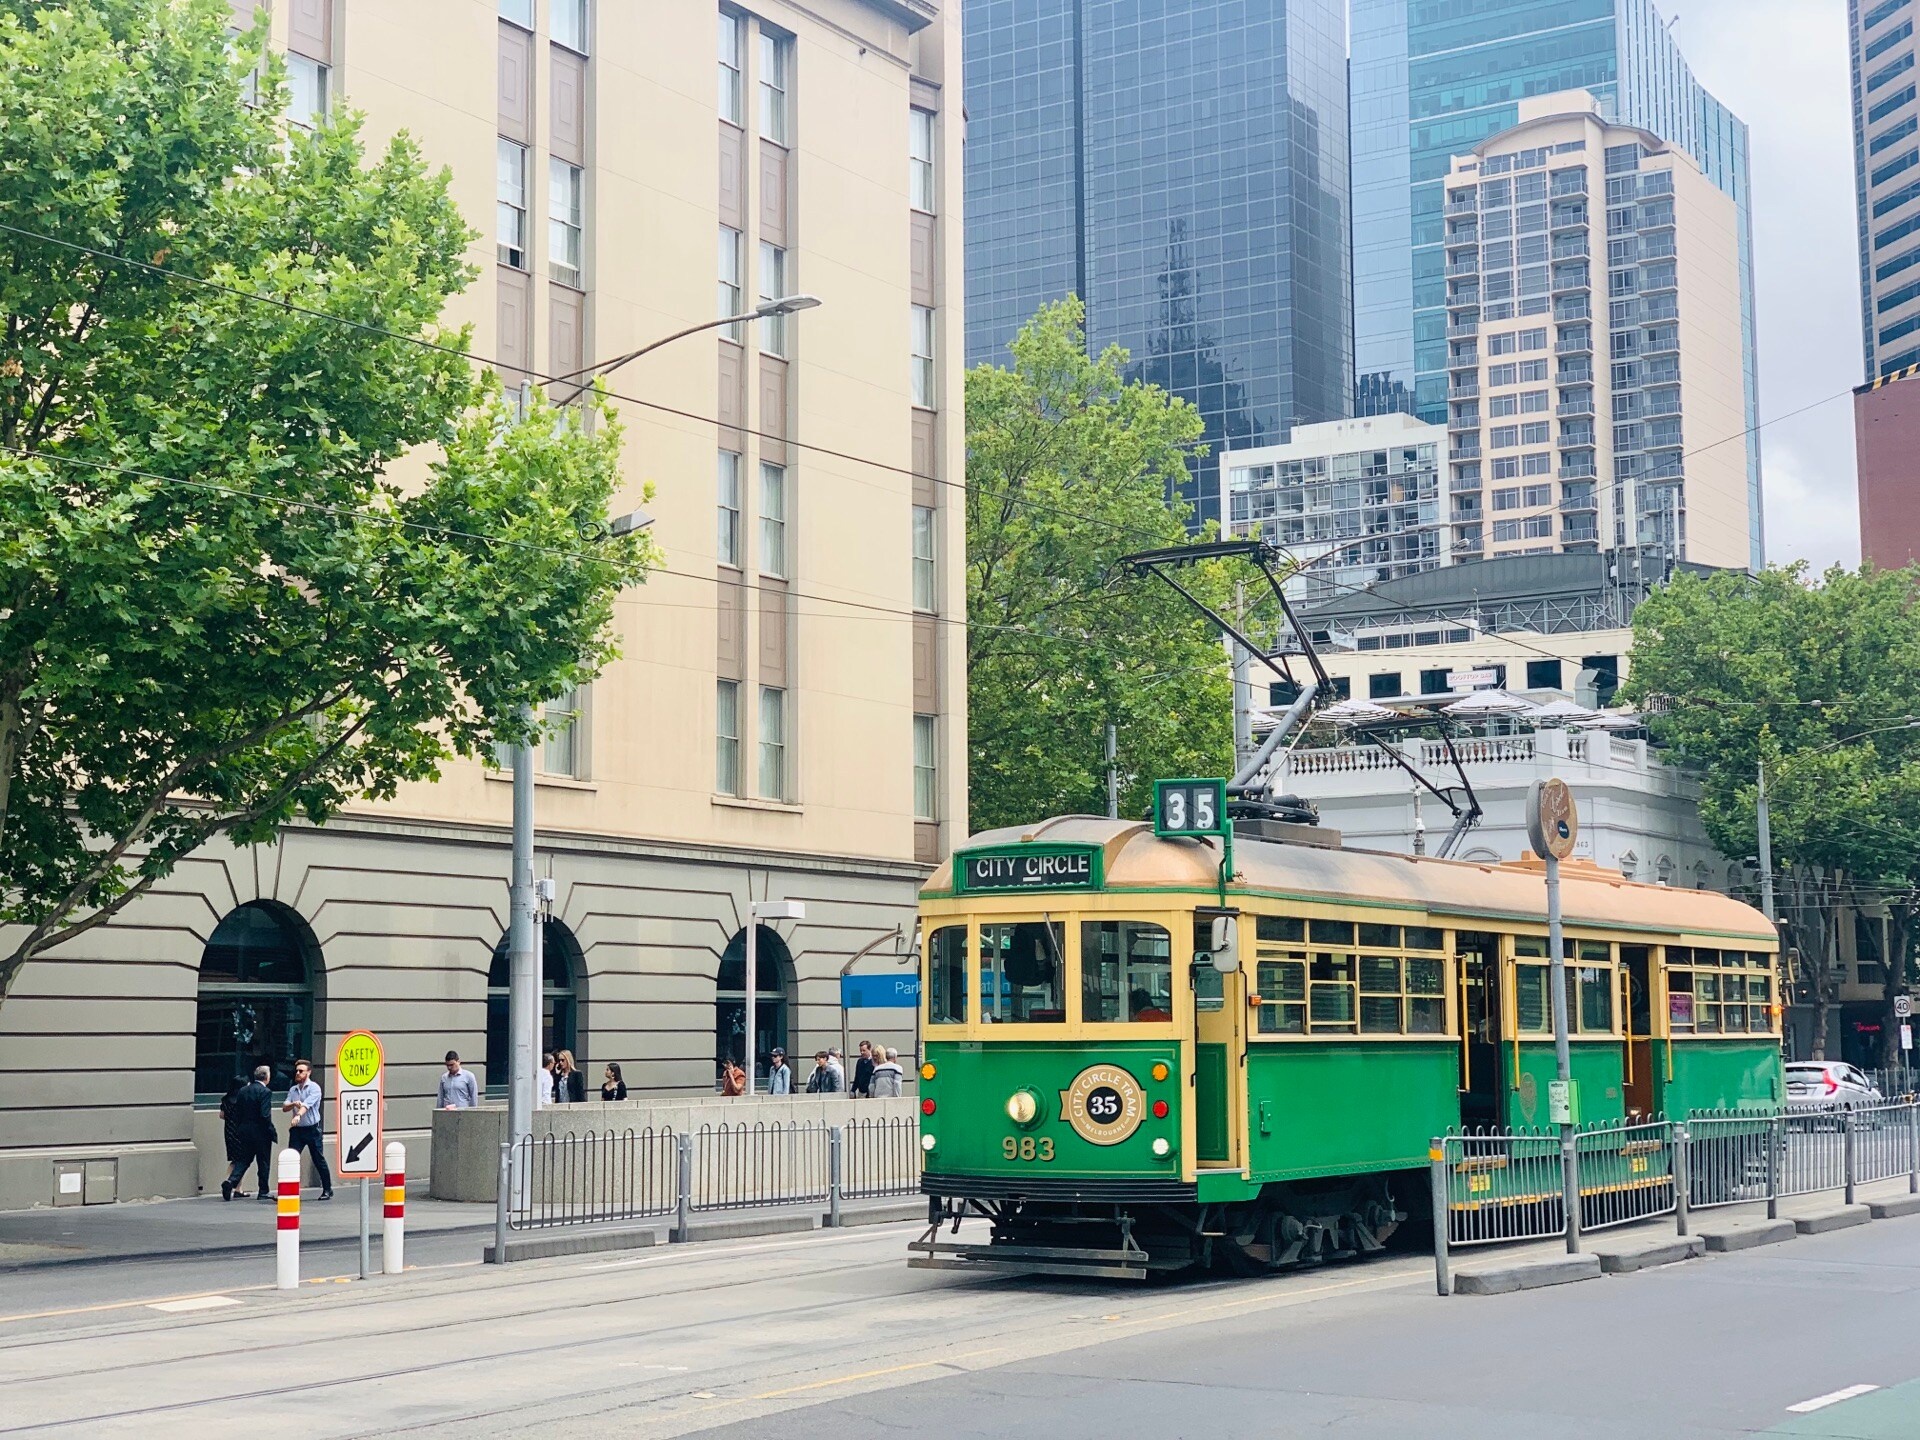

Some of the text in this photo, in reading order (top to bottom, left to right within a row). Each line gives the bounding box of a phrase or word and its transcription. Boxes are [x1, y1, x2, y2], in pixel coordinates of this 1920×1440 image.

[1167, 792, 1214, 829] 35
[976, 854, 1089, 878] CITY CIRCLE
[1896, 1002, 1908, 1011] 40
[344, 1048, 374, 1061] SAFETY
[349, 1064, 370, 1077] ZONE
[1073, 1071, 1137, 1117] CITY CIRCLE TRAM
[346, 1098, 373, 1111] KEEP
[1090, 1095, 1118, 1115] 35
[347, 1113, 372, 1126] LEFT
[1085, 1123, 1126, 1136] MELBOURNE
[1002, 1135, 1055, 1161] 983
